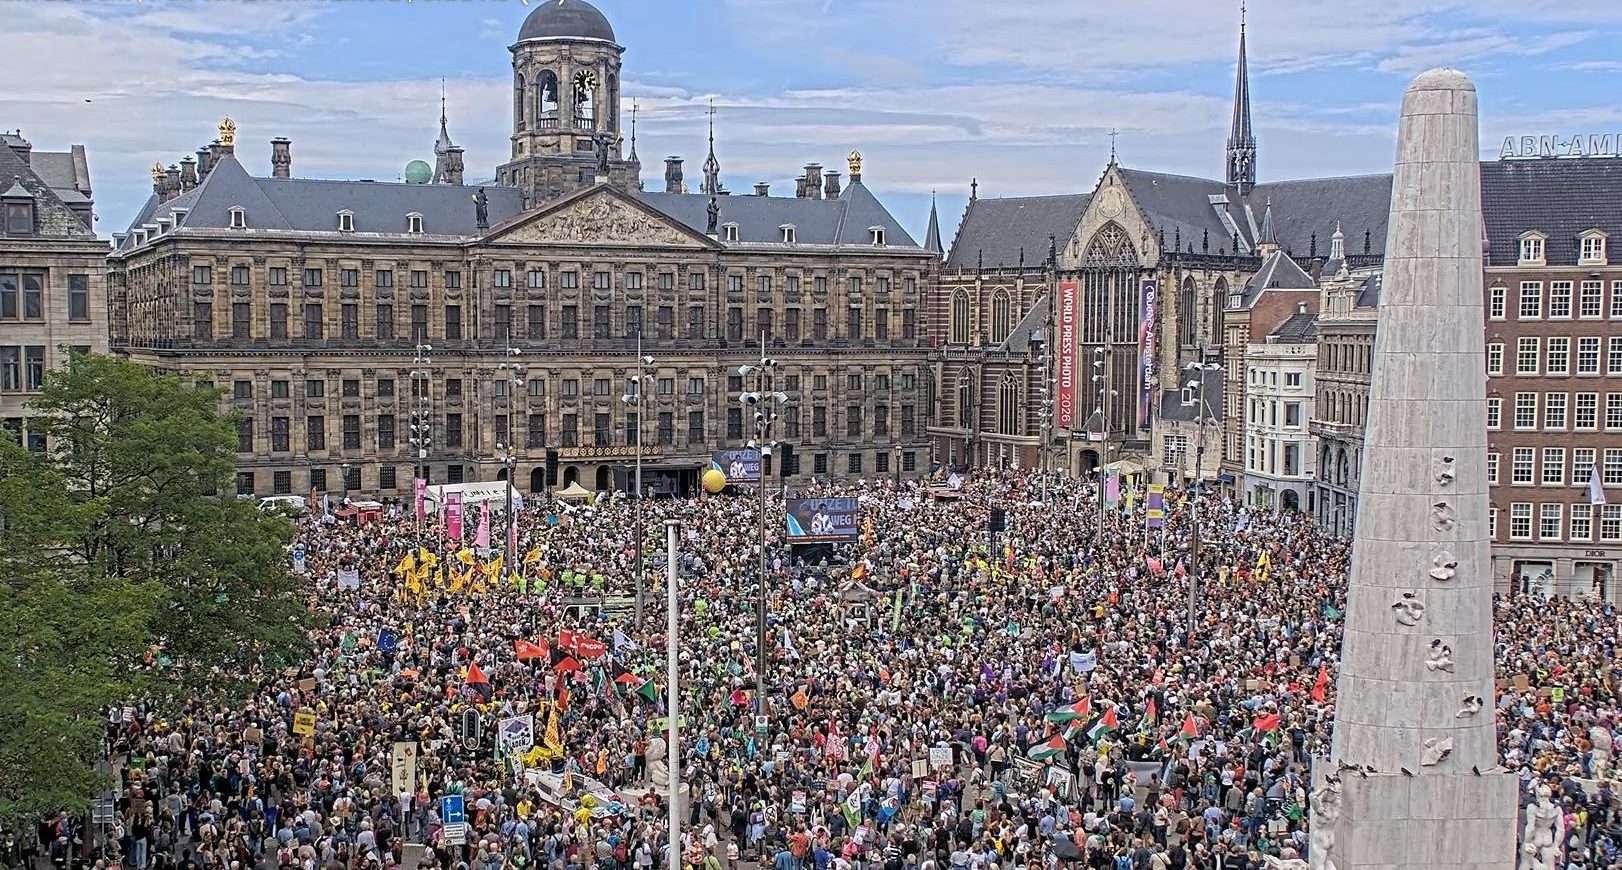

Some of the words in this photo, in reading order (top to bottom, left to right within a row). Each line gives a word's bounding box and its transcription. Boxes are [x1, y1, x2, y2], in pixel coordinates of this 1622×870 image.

[1500, 135, 1559, 157] ABN
[1063, 288, 1073, 323] WORLD
[1062, 325, 1072, 354] PRESS
[1062, 356, 1072, 388] PHOTO
[1061, 393, 1071, 422] 2026
[830, 514, 851, 525] WEG
